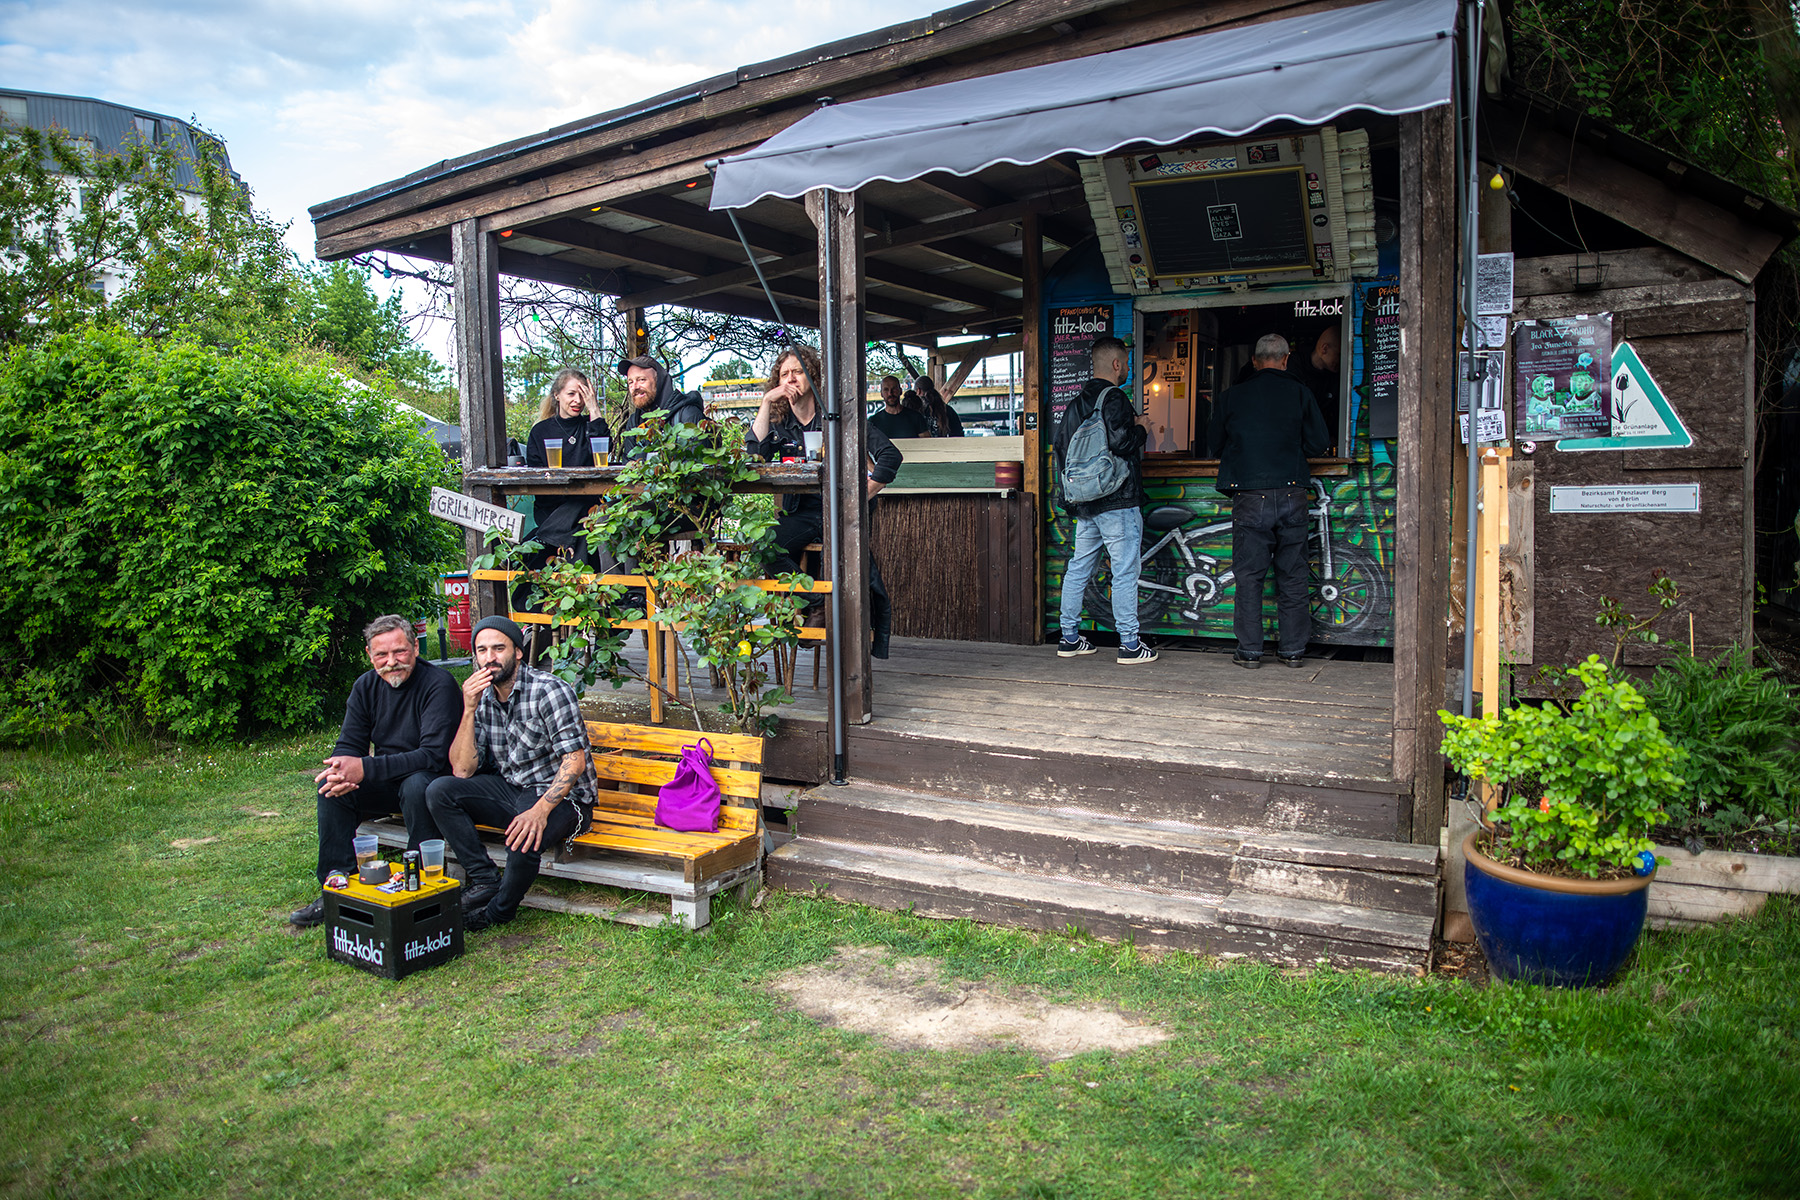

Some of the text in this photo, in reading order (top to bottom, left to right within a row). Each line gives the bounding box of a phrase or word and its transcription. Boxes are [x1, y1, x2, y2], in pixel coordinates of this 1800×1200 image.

[1054, 315, 1106, 334] fritz-kola
[1054, 334, 1070, 343] BIER
[1531, 329, 1553, 339] BLACK
[1544, 341, 1572, 349] Funesta
[437, 495, 515, 532] GRILL MERCH
[334, 926, 451, 966] fritz-kola fritz-kola
